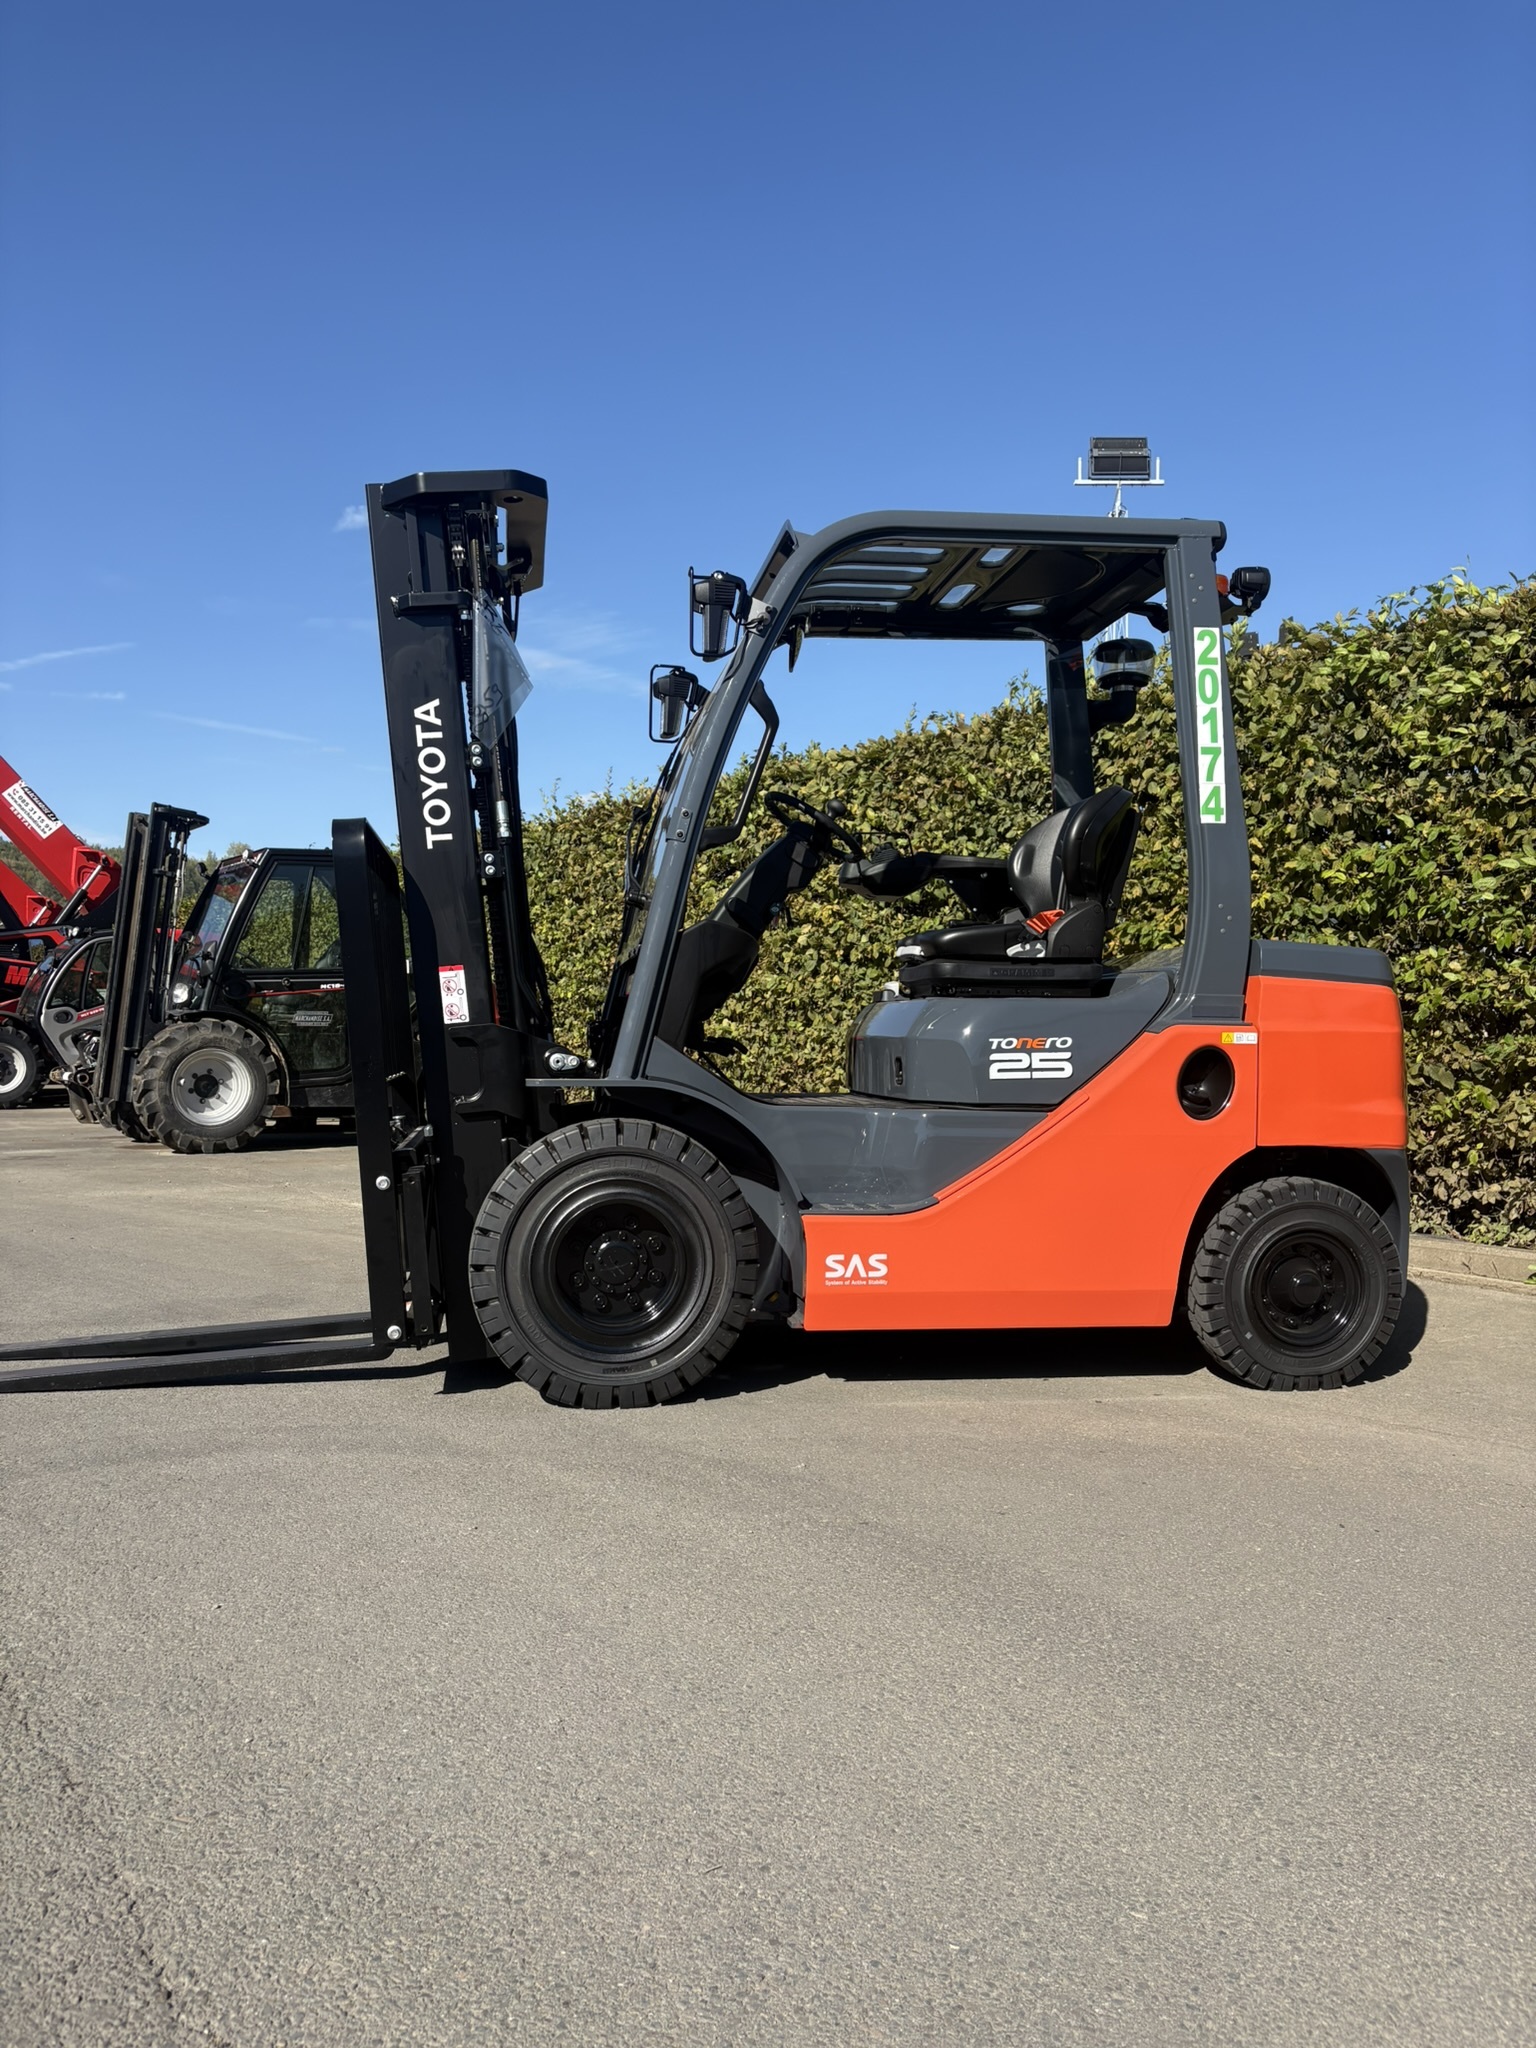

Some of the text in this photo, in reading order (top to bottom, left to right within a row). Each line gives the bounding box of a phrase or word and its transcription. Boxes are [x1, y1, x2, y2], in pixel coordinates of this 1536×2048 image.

[1197, 629, 1224, 822] 20174
[414, 698, 453, 849] TOYOTA
[7, 792, 47, 835] www.marchandise.be
[9, 806, 32, 830] RENTAL
[17, 794, 30, 807] 085
[28, 806, 37, 815] 31
[44, 823, 53, 832] 91
[989, 1052, 1073, 1080] 25
[825, 1253, 888, 1278] SAS
